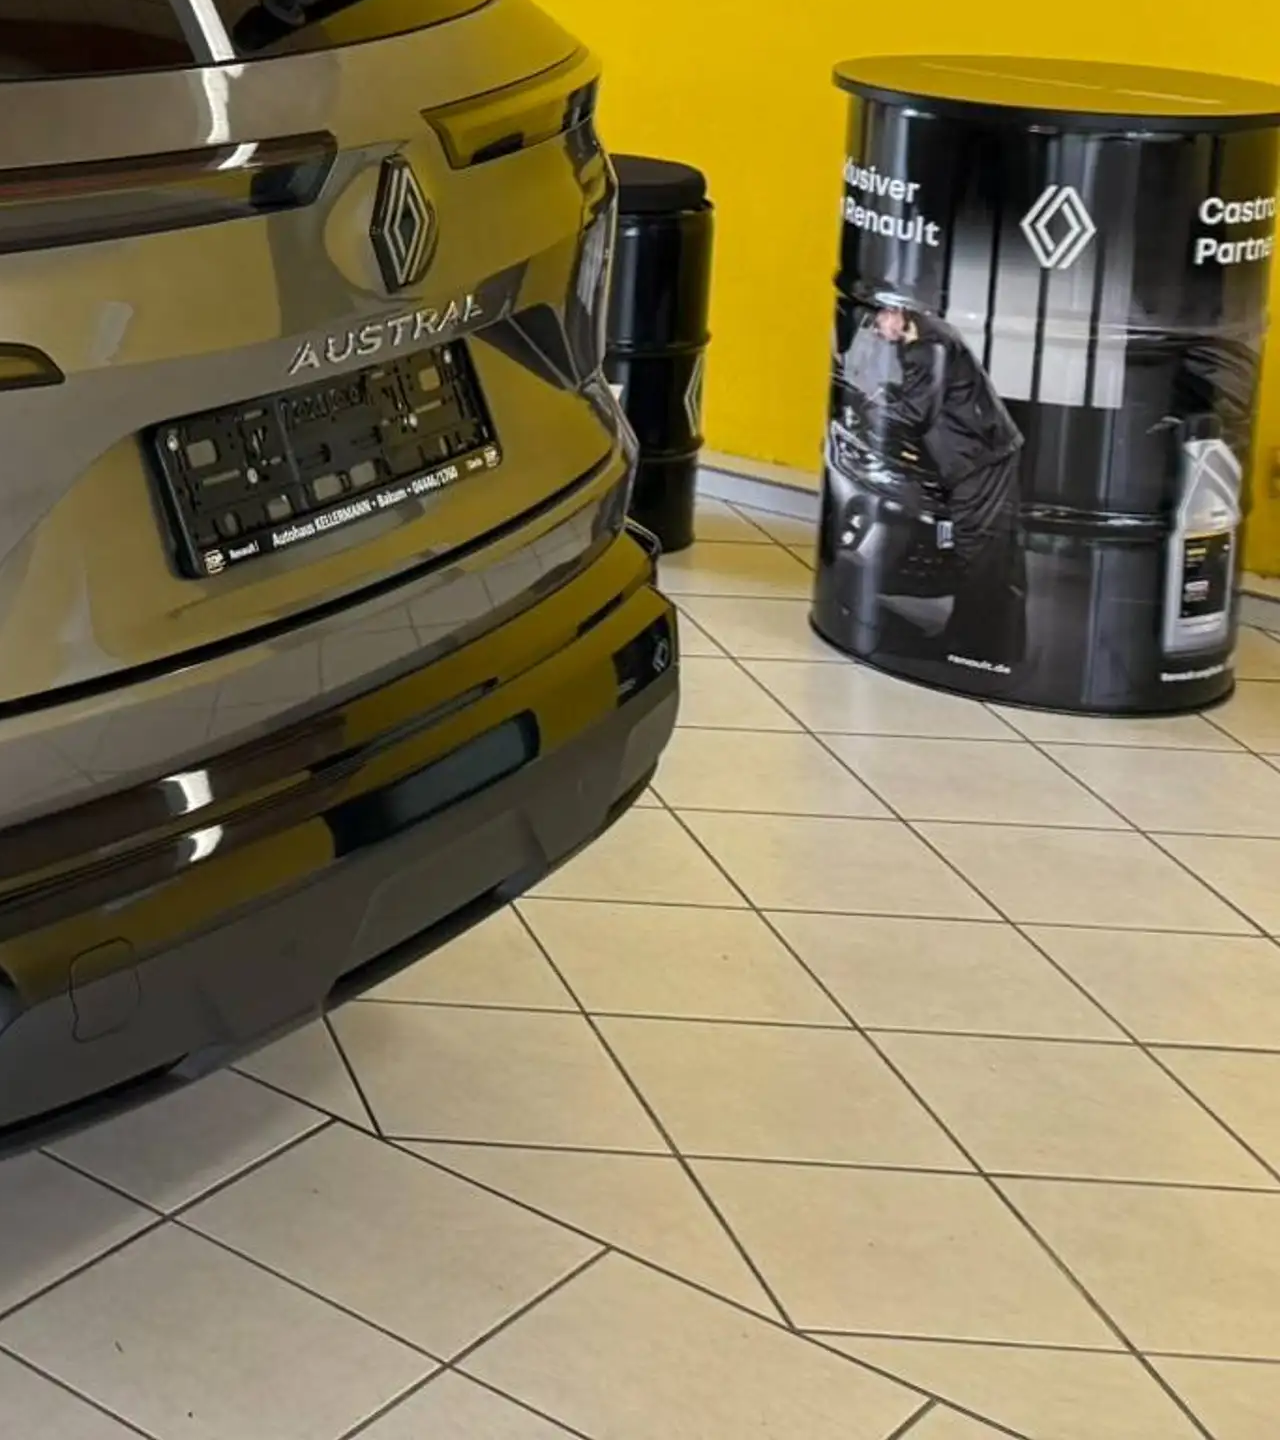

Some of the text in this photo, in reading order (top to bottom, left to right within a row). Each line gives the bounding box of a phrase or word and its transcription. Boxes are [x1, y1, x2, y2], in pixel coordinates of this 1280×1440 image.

[844, 196, 941, 248] Renault
[288, 293, 484, 376] AUSTRAL
[314, 499, 373, 532] KELLERMANN
